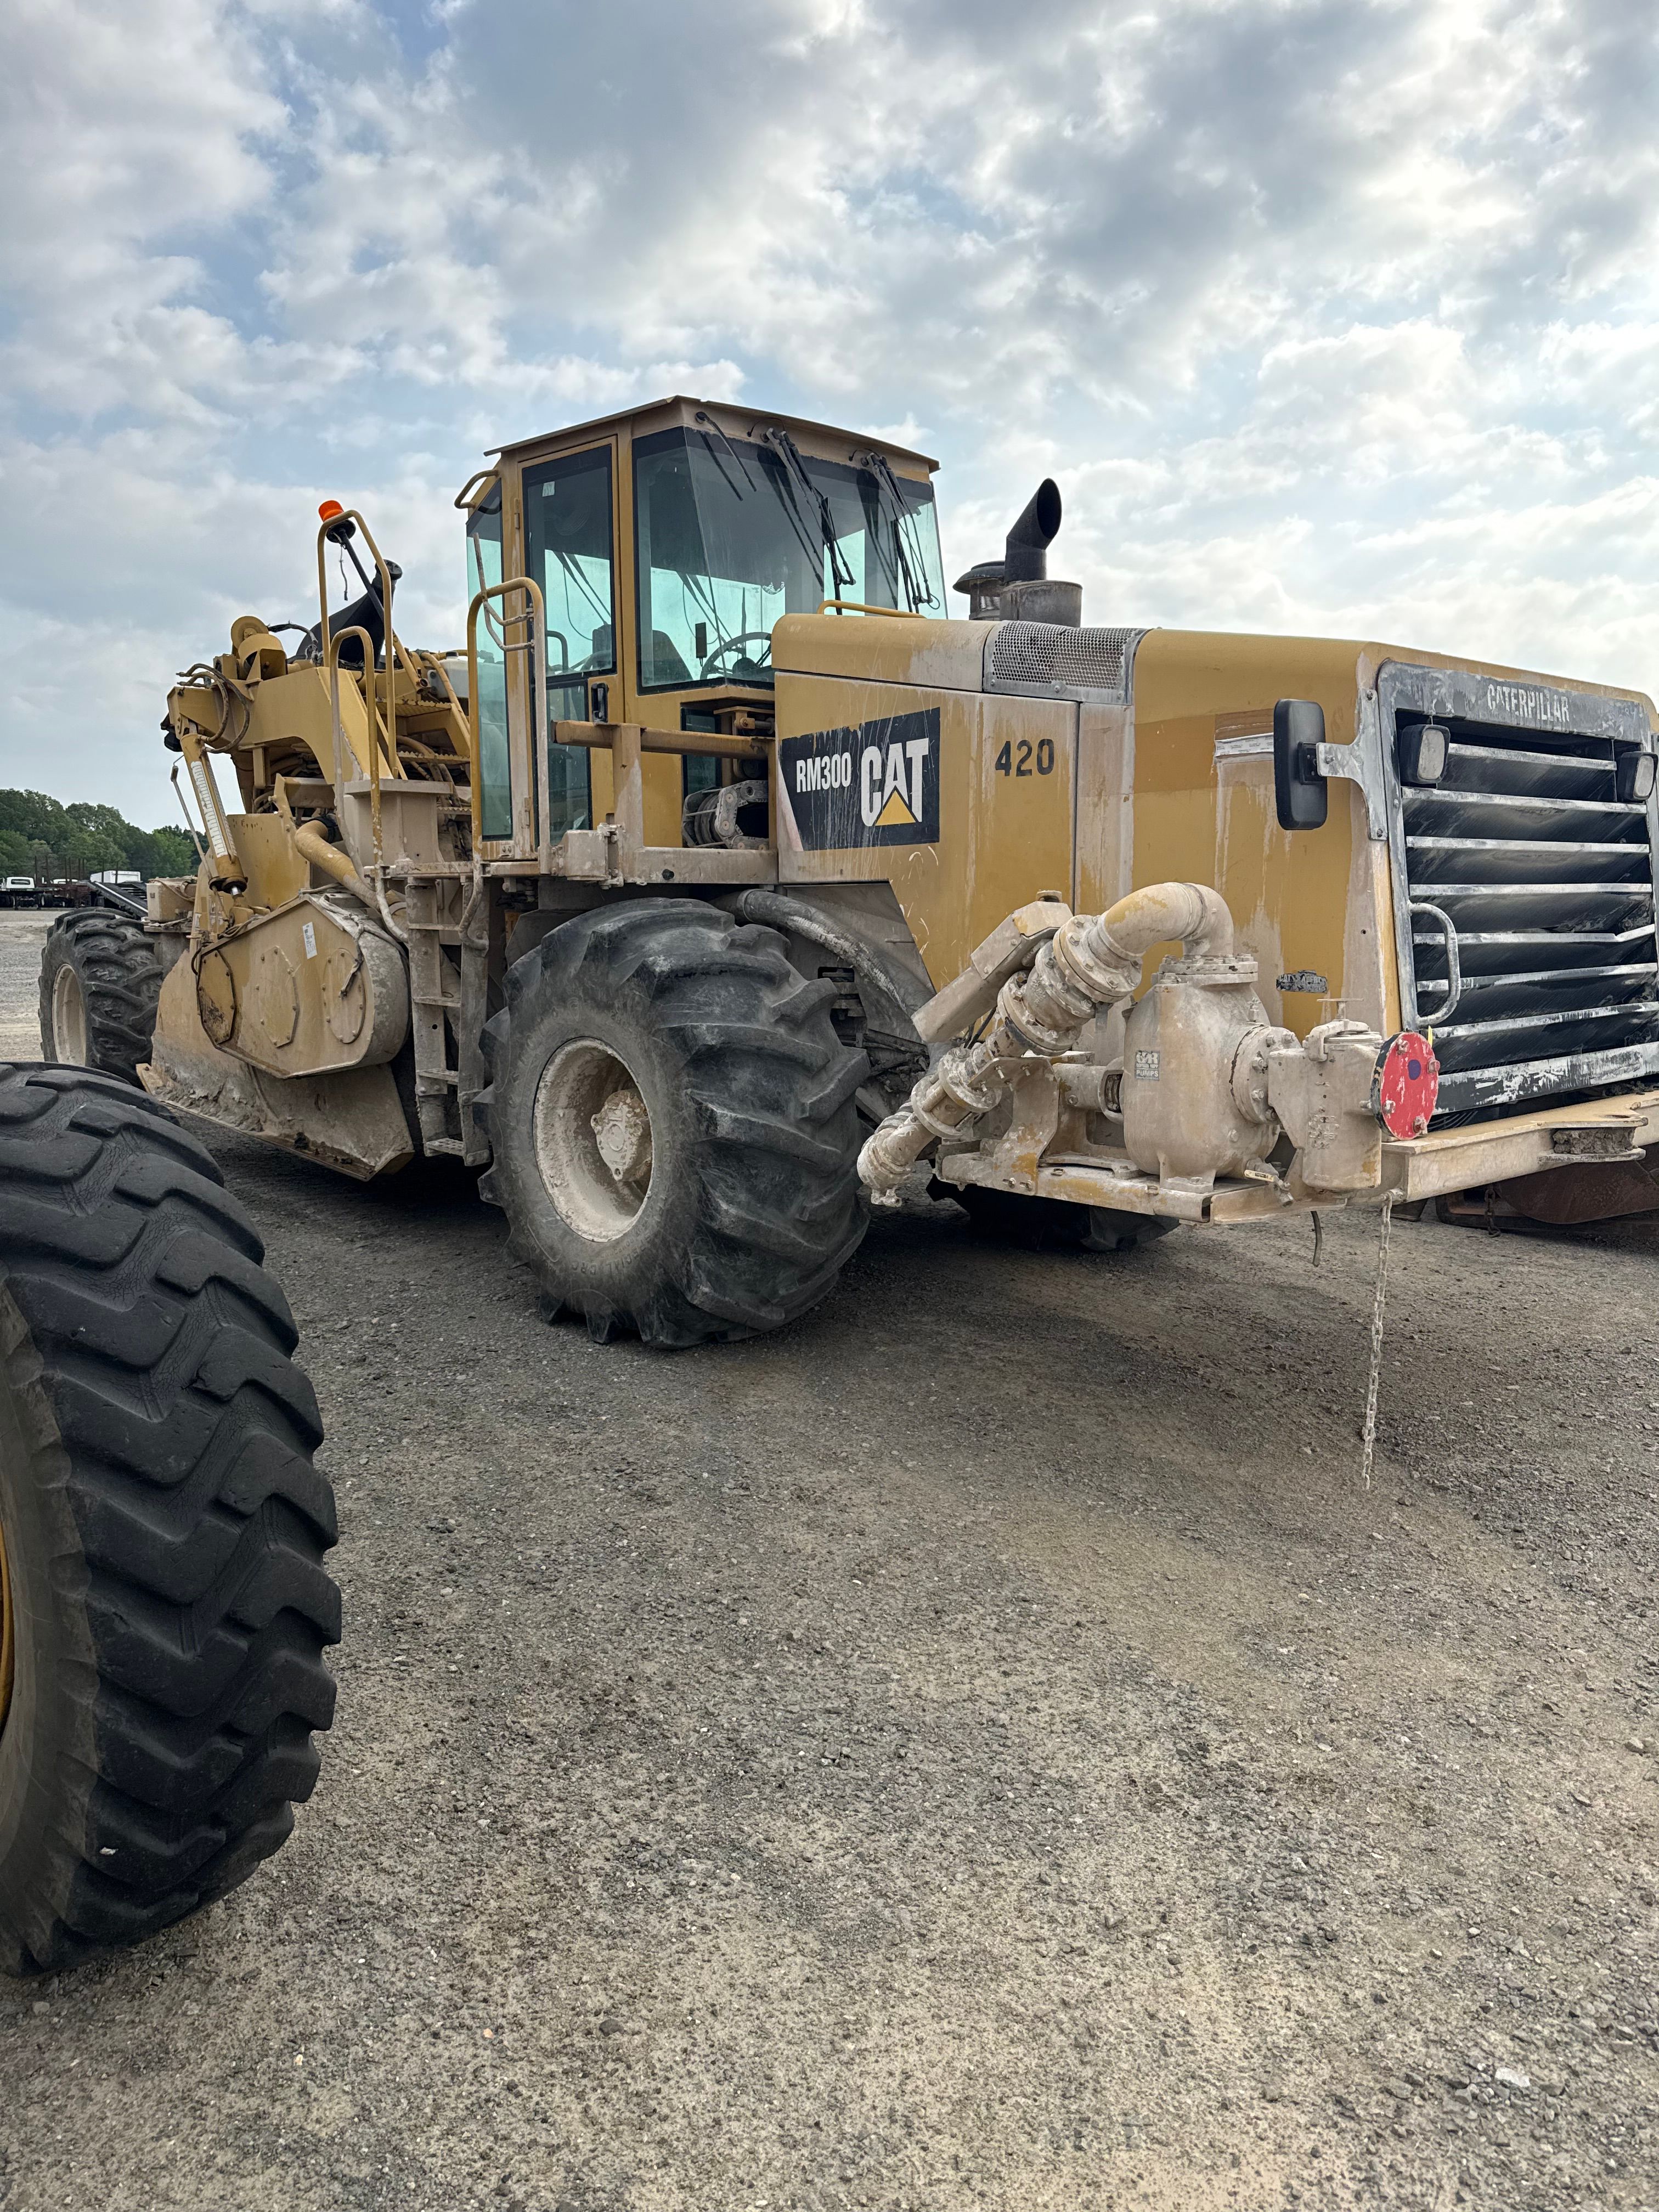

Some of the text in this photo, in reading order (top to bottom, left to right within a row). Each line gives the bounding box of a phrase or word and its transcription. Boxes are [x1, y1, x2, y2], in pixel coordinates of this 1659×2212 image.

[1487, 684, 1570, 723] CATERPILLAR
[995, 738, 1054, 777] 420
[796, 738, 929, 827] RM300 CAT
